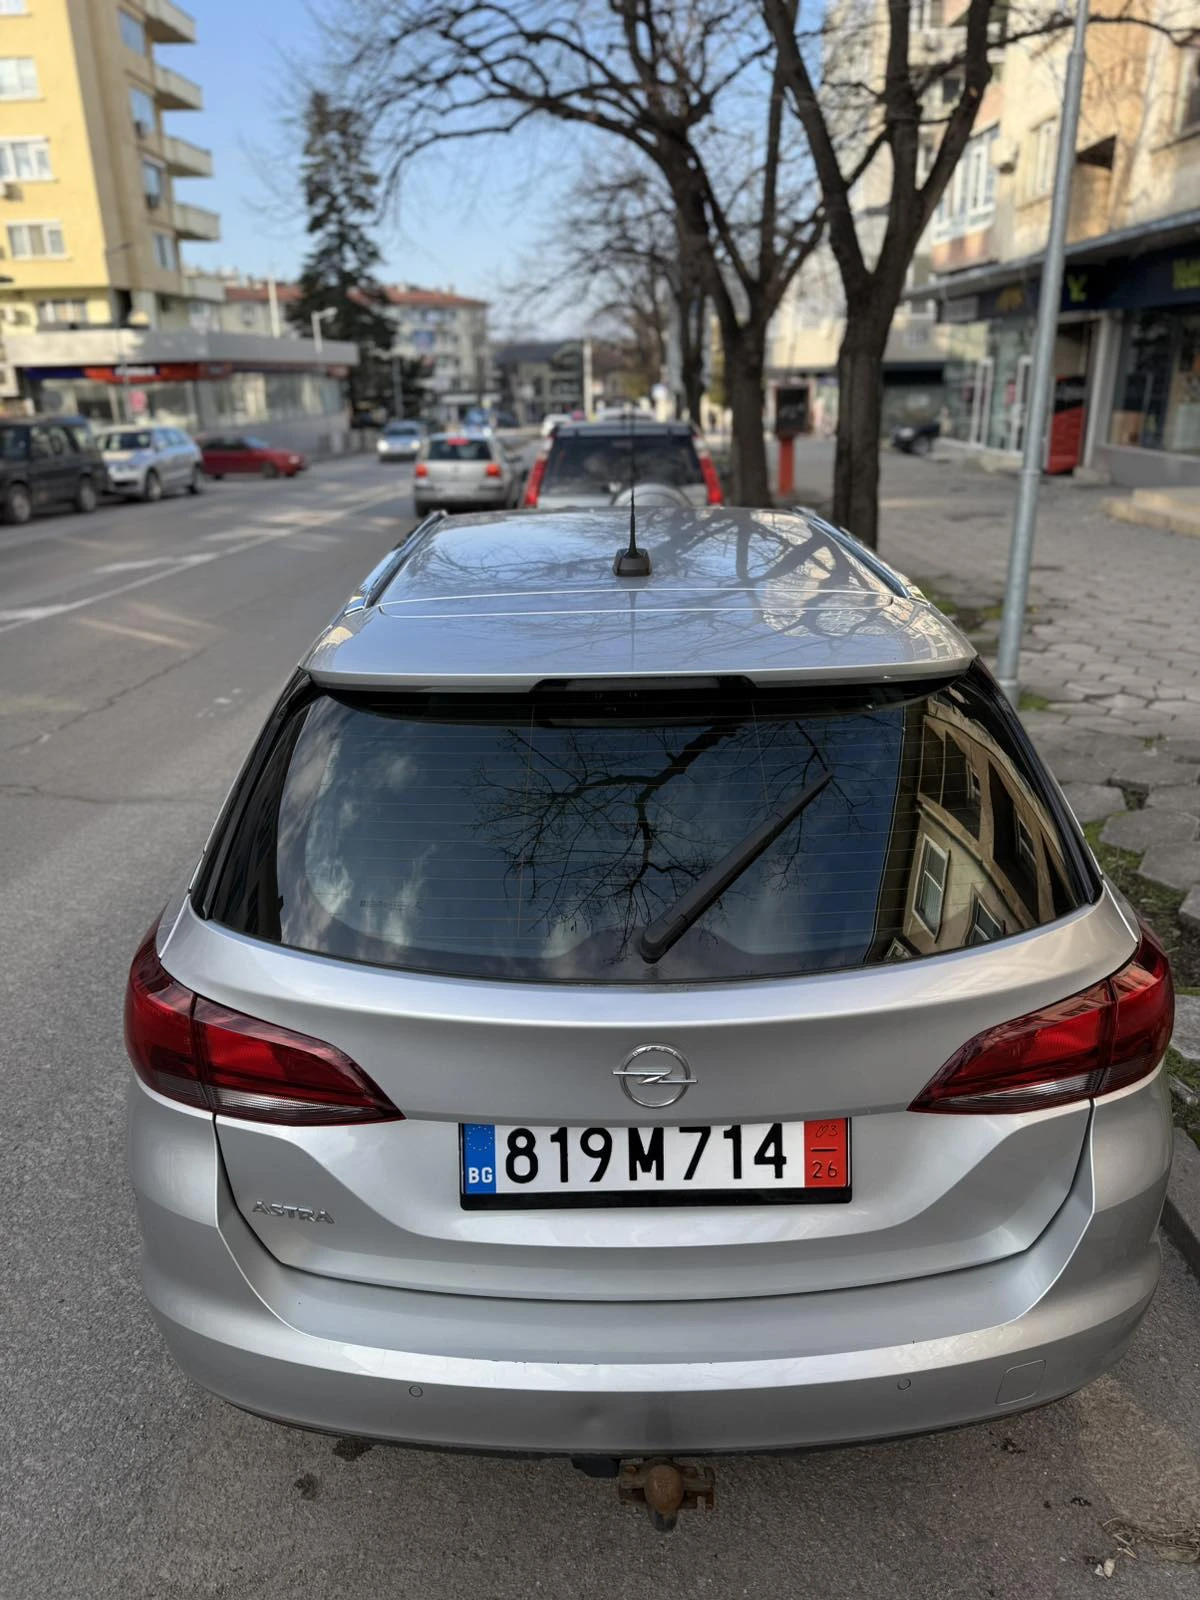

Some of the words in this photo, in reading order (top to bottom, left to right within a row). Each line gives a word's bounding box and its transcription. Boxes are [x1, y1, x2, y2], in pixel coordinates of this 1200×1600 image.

[468, 1167, 493, 1183] BG
[812, 1160, 838, 1179] 26
[252, 1200, 335, 1224] ASTRA
